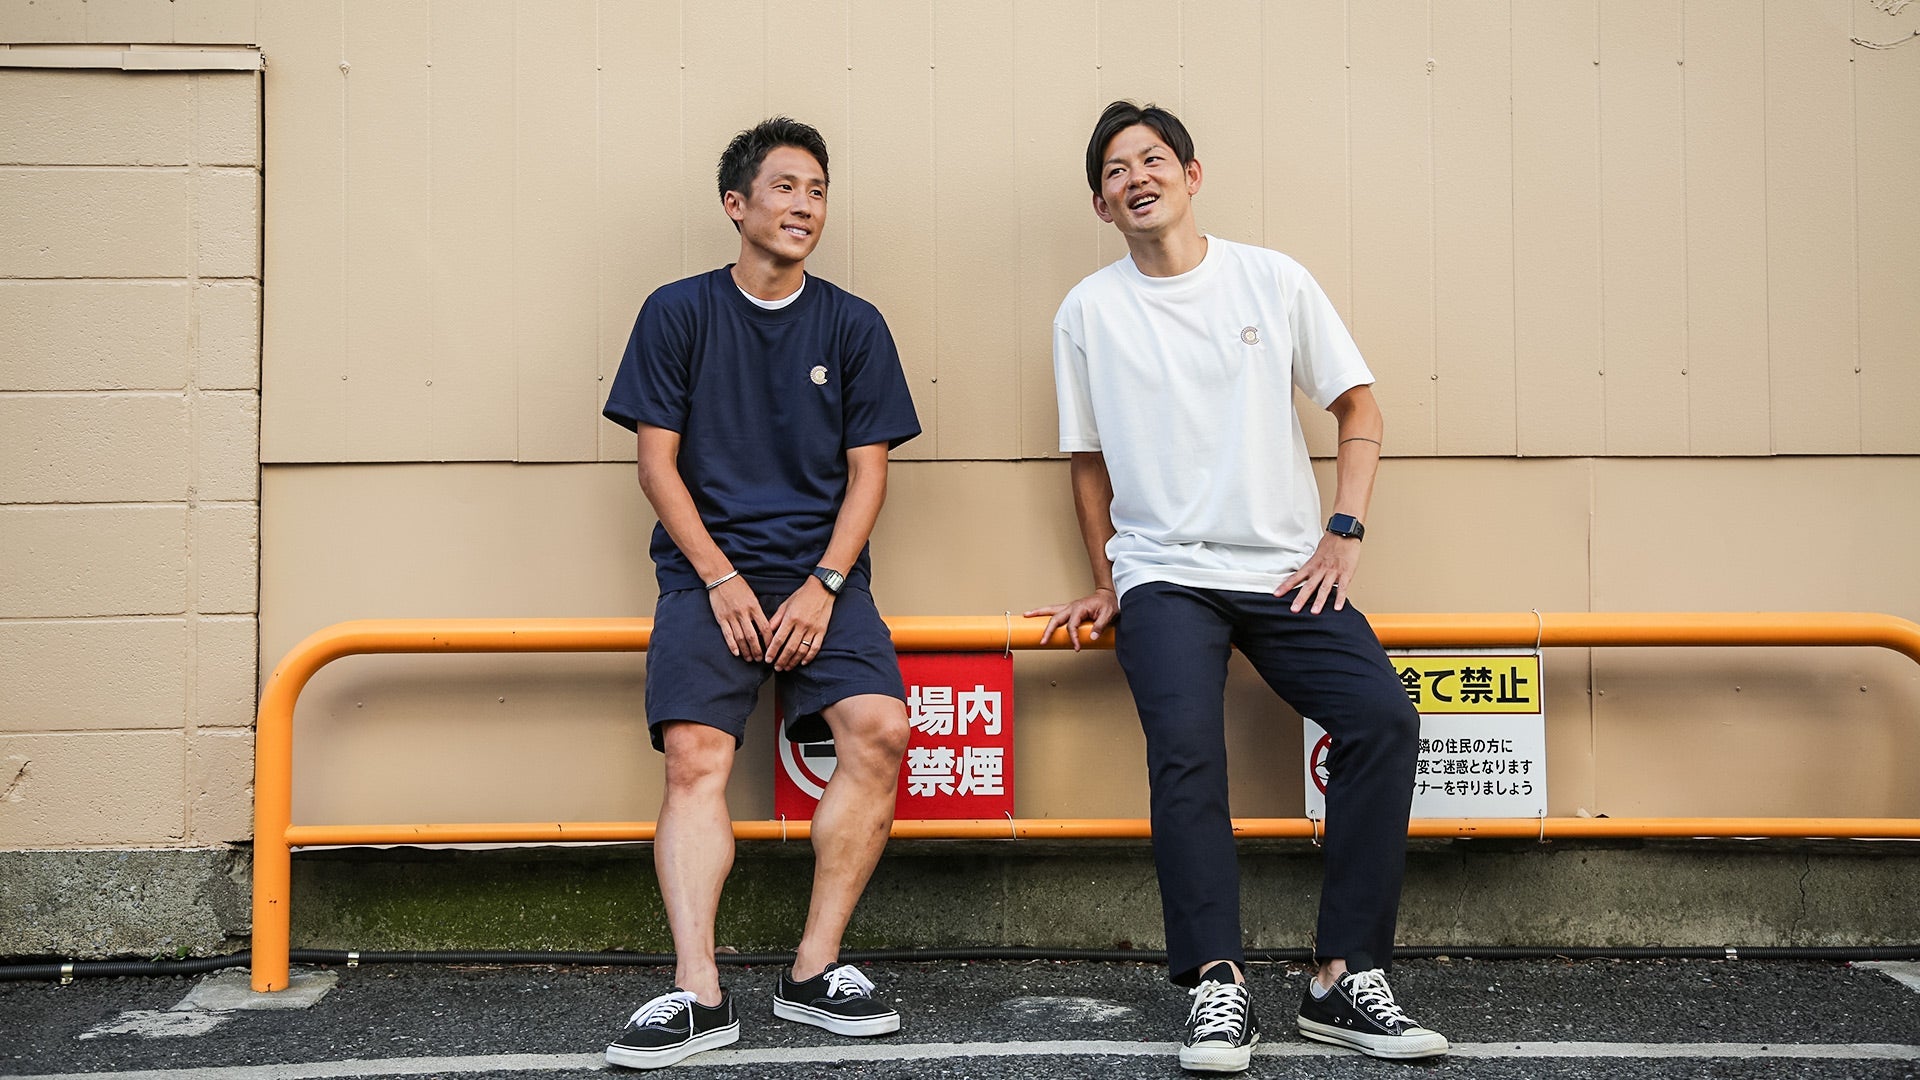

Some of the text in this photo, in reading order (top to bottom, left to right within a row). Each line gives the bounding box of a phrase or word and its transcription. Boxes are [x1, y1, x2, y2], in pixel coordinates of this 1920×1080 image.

[907, 685, 1003, 736] 場内
[907, 746, 1005, 797] 禁煙
[1417, 758, 1533, 775] 変ご迷惑となります
[1413, 780, 1533, 796] ナーを守りましょう
